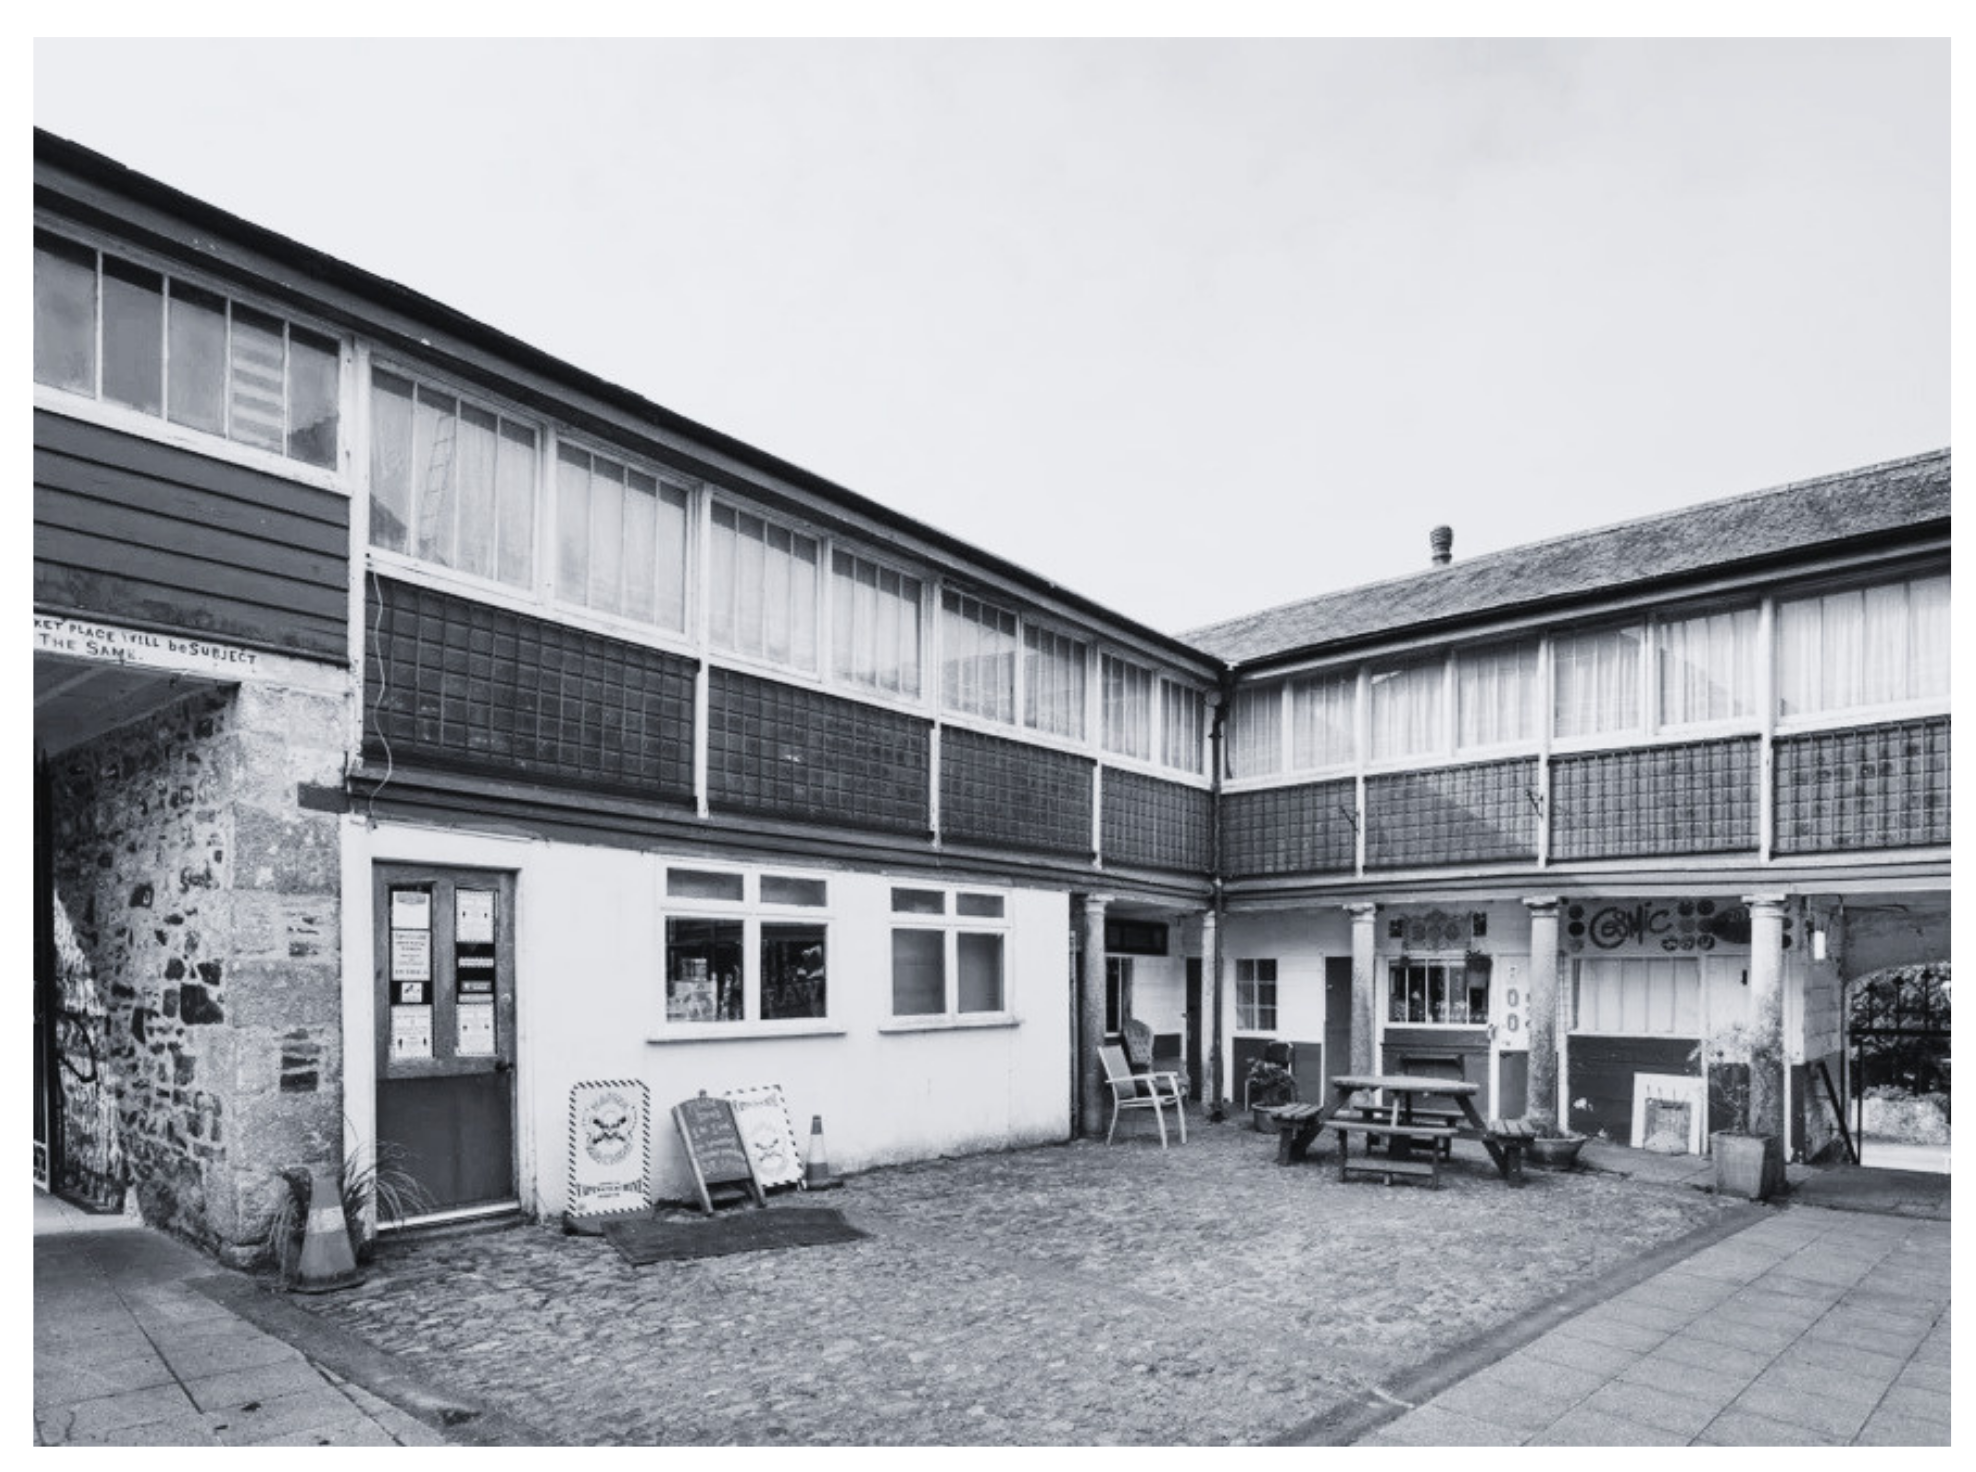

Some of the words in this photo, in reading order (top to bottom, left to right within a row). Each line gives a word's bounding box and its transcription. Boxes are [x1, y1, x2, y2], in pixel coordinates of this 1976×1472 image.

[39, 633, 77, 650] THE
[69, 623, 115, 642] PLACE
[121, 630, 160, 648] WILL
